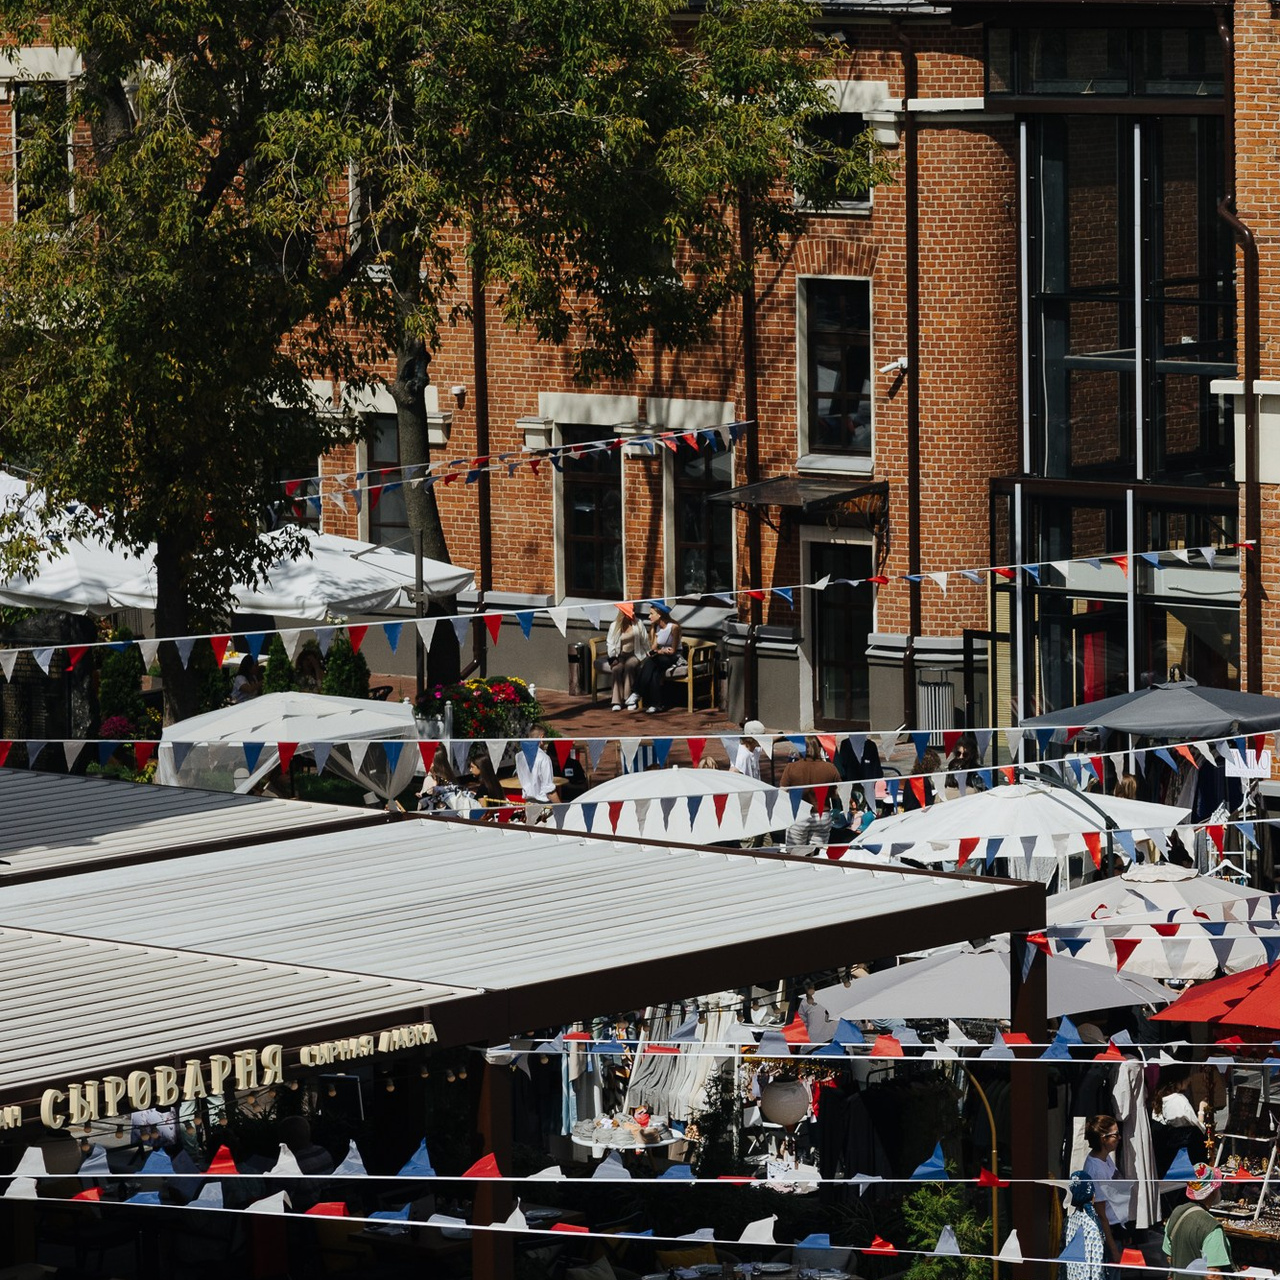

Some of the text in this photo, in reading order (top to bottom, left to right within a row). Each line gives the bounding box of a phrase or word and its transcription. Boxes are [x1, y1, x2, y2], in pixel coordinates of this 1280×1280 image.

[40, 1044, 284, 1130] СЫРОВАРНЯ
[300, 1035, 374, 1067] СЫРНАЯ
[378, 1023, 438, 1053] ЛАВКА
